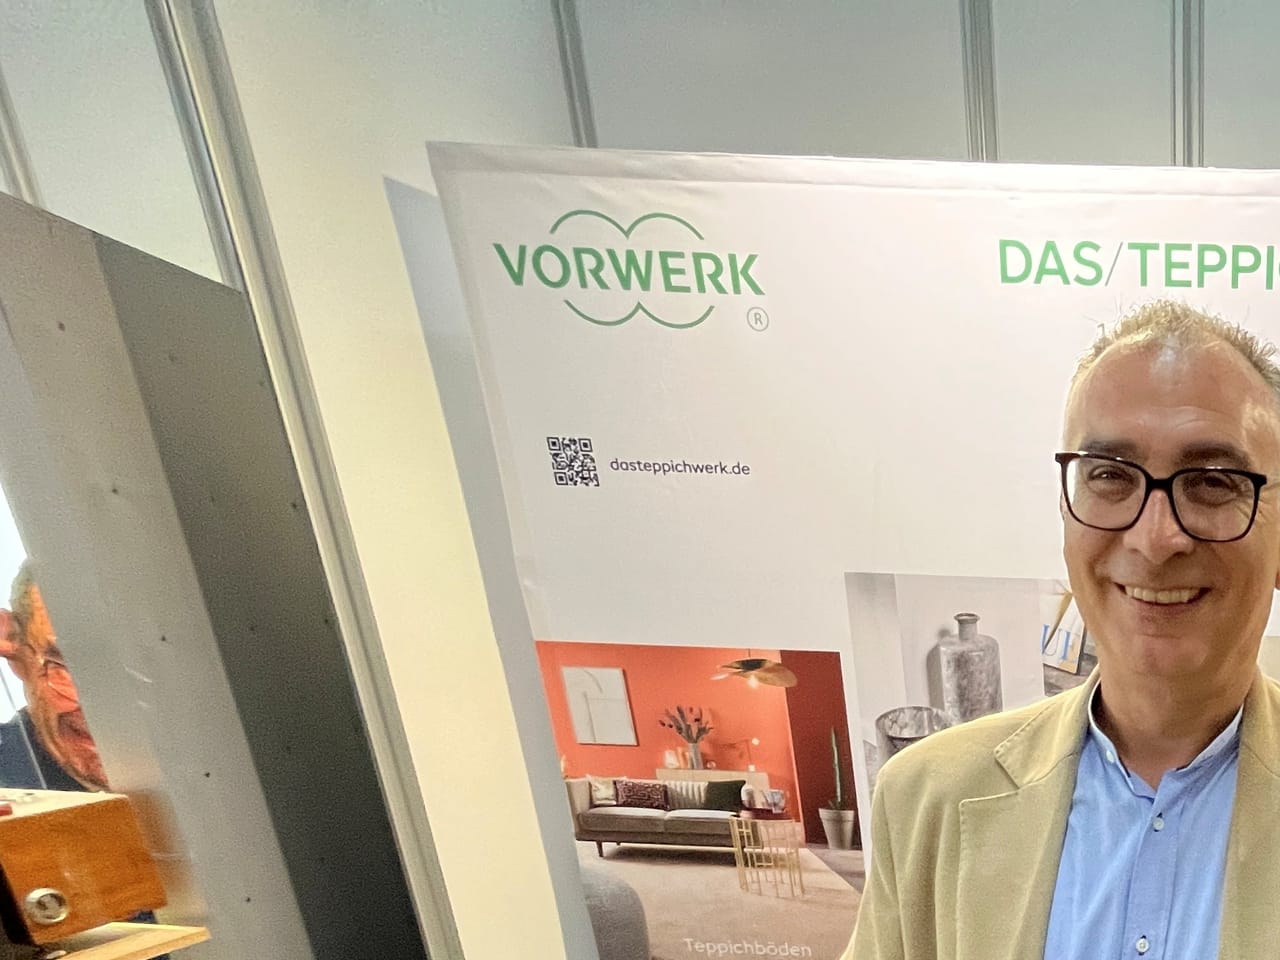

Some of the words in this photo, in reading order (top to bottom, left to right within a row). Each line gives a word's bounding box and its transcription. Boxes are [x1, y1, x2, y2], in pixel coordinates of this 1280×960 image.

[492, 242, 765, 296] VORWERK
[609, 457, 751, 477] dasteppichwerk.de
[683, 937, 812, 958] Teppichböden
